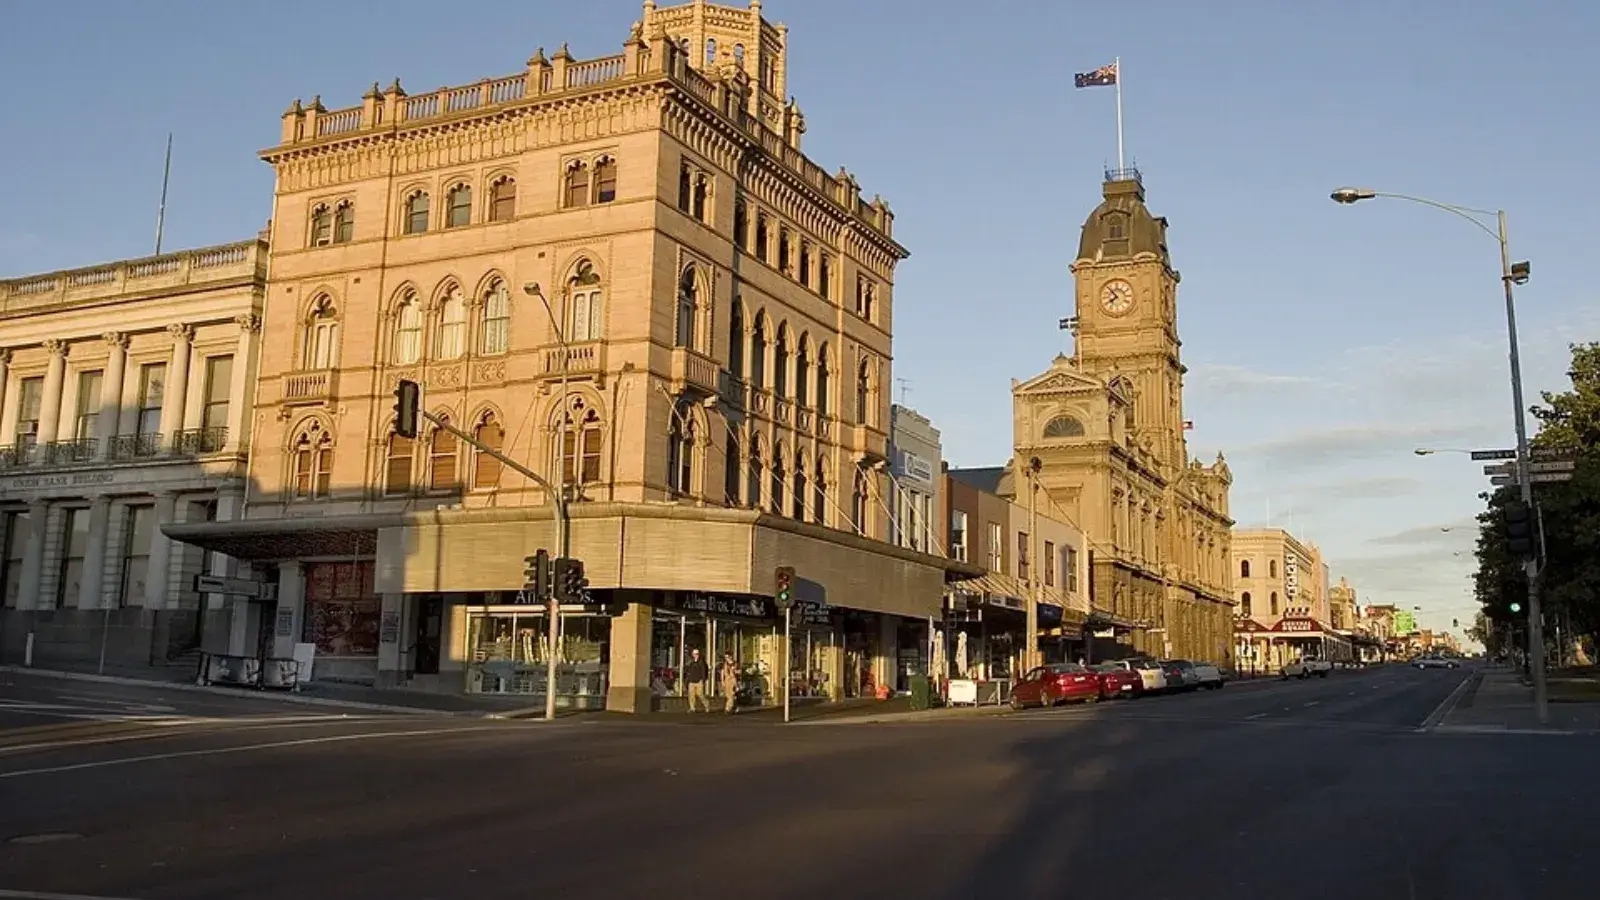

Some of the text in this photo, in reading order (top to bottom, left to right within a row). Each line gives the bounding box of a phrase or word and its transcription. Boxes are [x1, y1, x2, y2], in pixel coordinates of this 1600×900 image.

[12, 474, 114, 488] UNION BANK BUILDING
